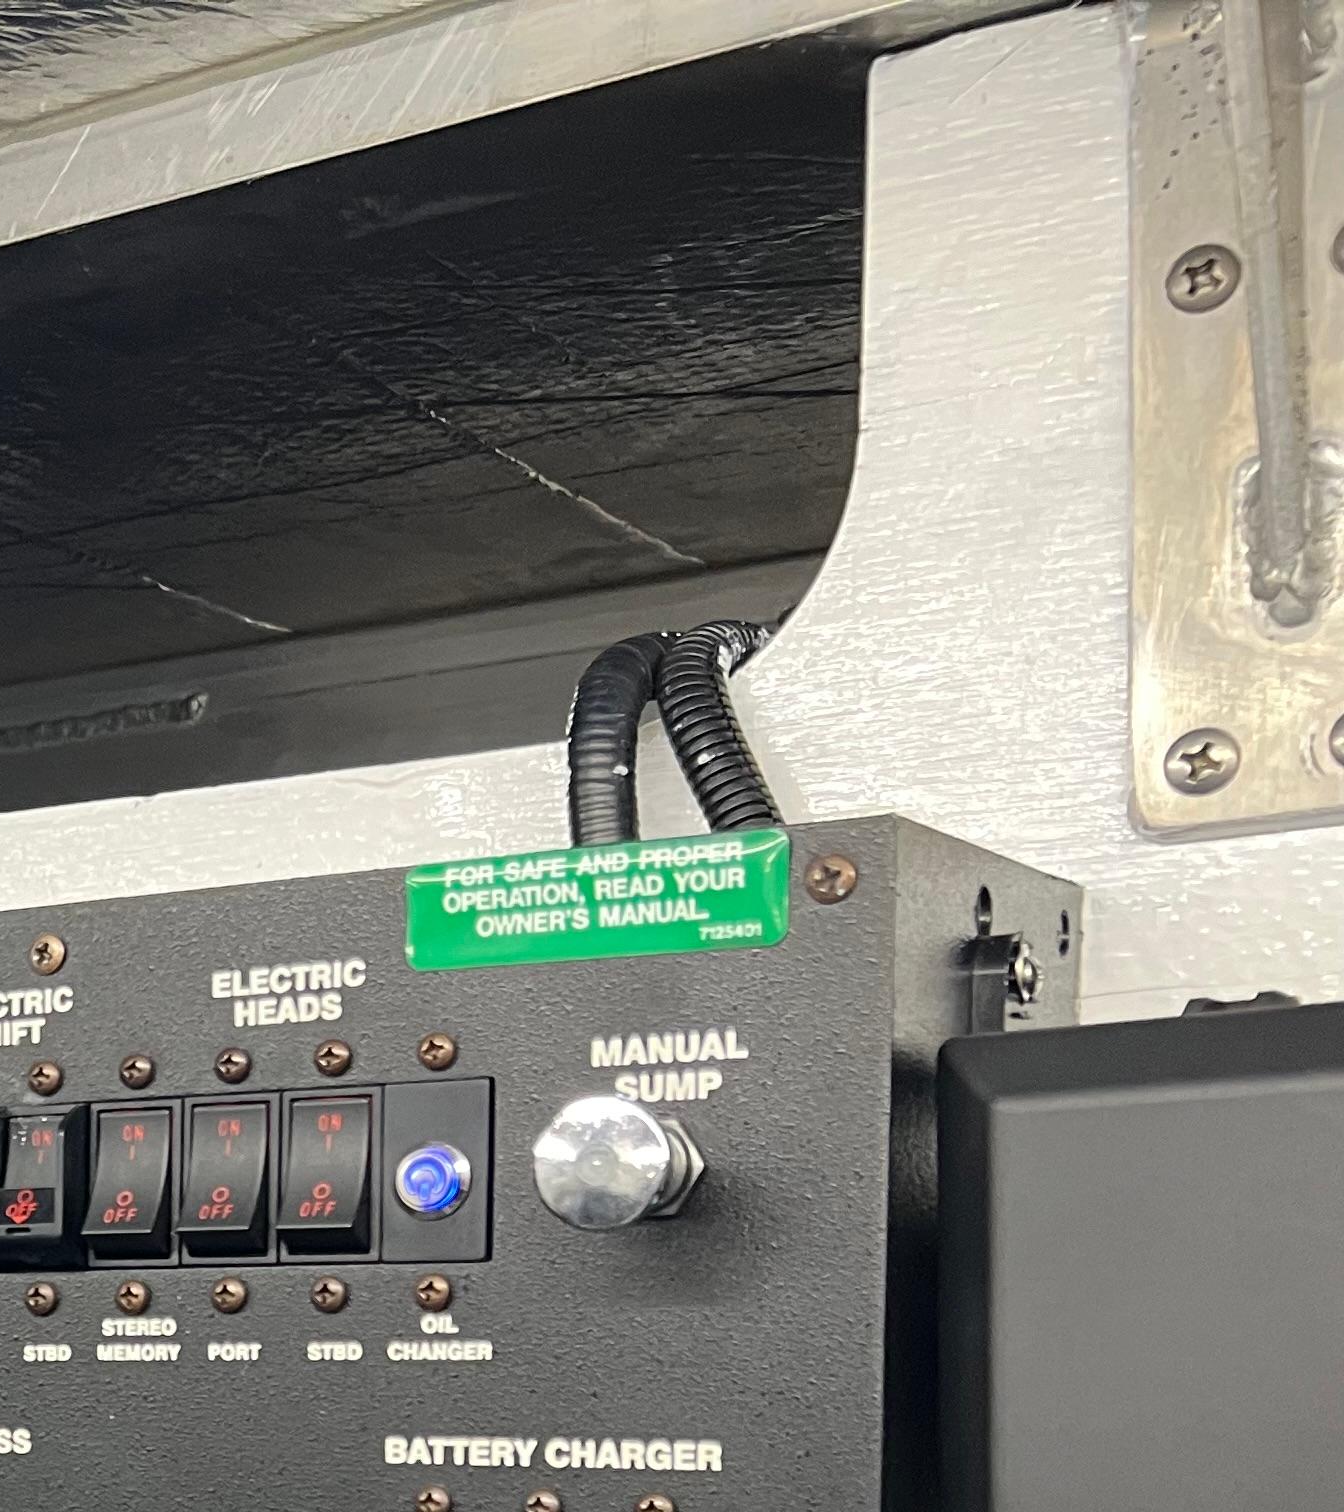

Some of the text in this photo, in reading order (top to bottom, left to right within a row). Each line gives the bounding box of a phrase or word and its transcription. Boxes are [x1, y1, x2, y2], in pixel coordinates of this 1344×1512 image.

[444, 842, 742, 888] FOR SAFE AND PROPER
[444, 868, 745, 913] OPERATION, READ YOUR
[476, 911, 589, 937] OWNER'S
[212, 958, 366, 998] ELECTRIC
[234, 992, 342, 1027] HEADS
[591, 1029, 748, 1067] MANUAL
[614, 1070, 722, 1103] SUMP
[218, 1120, 240, 1136] ON
[318, 1114, 342, 1131] ON
[123, 1125, 144, 1141] ON
[5, 1202, 37, 1218] OFF
[103, 1208, 137, 1223] OFF
[199, 1204, 234, 1219] OFF
[299, 1201, 336, 1217] OFF
[102, 1318, 177, 1336] STEREO
[421, 1314, 459, 1334] OIL
[23, 1344, 71, 1361] STBD
[97, 1344, 181, 1361] MEMORY
[208, 1343, 261, 1361] PORT
[307, 1342, 362, 1360] STBD
[387, 1341, 492, 1360] CHANGER
[385, 1436, 722, 1471] BATTERY CHARGER
